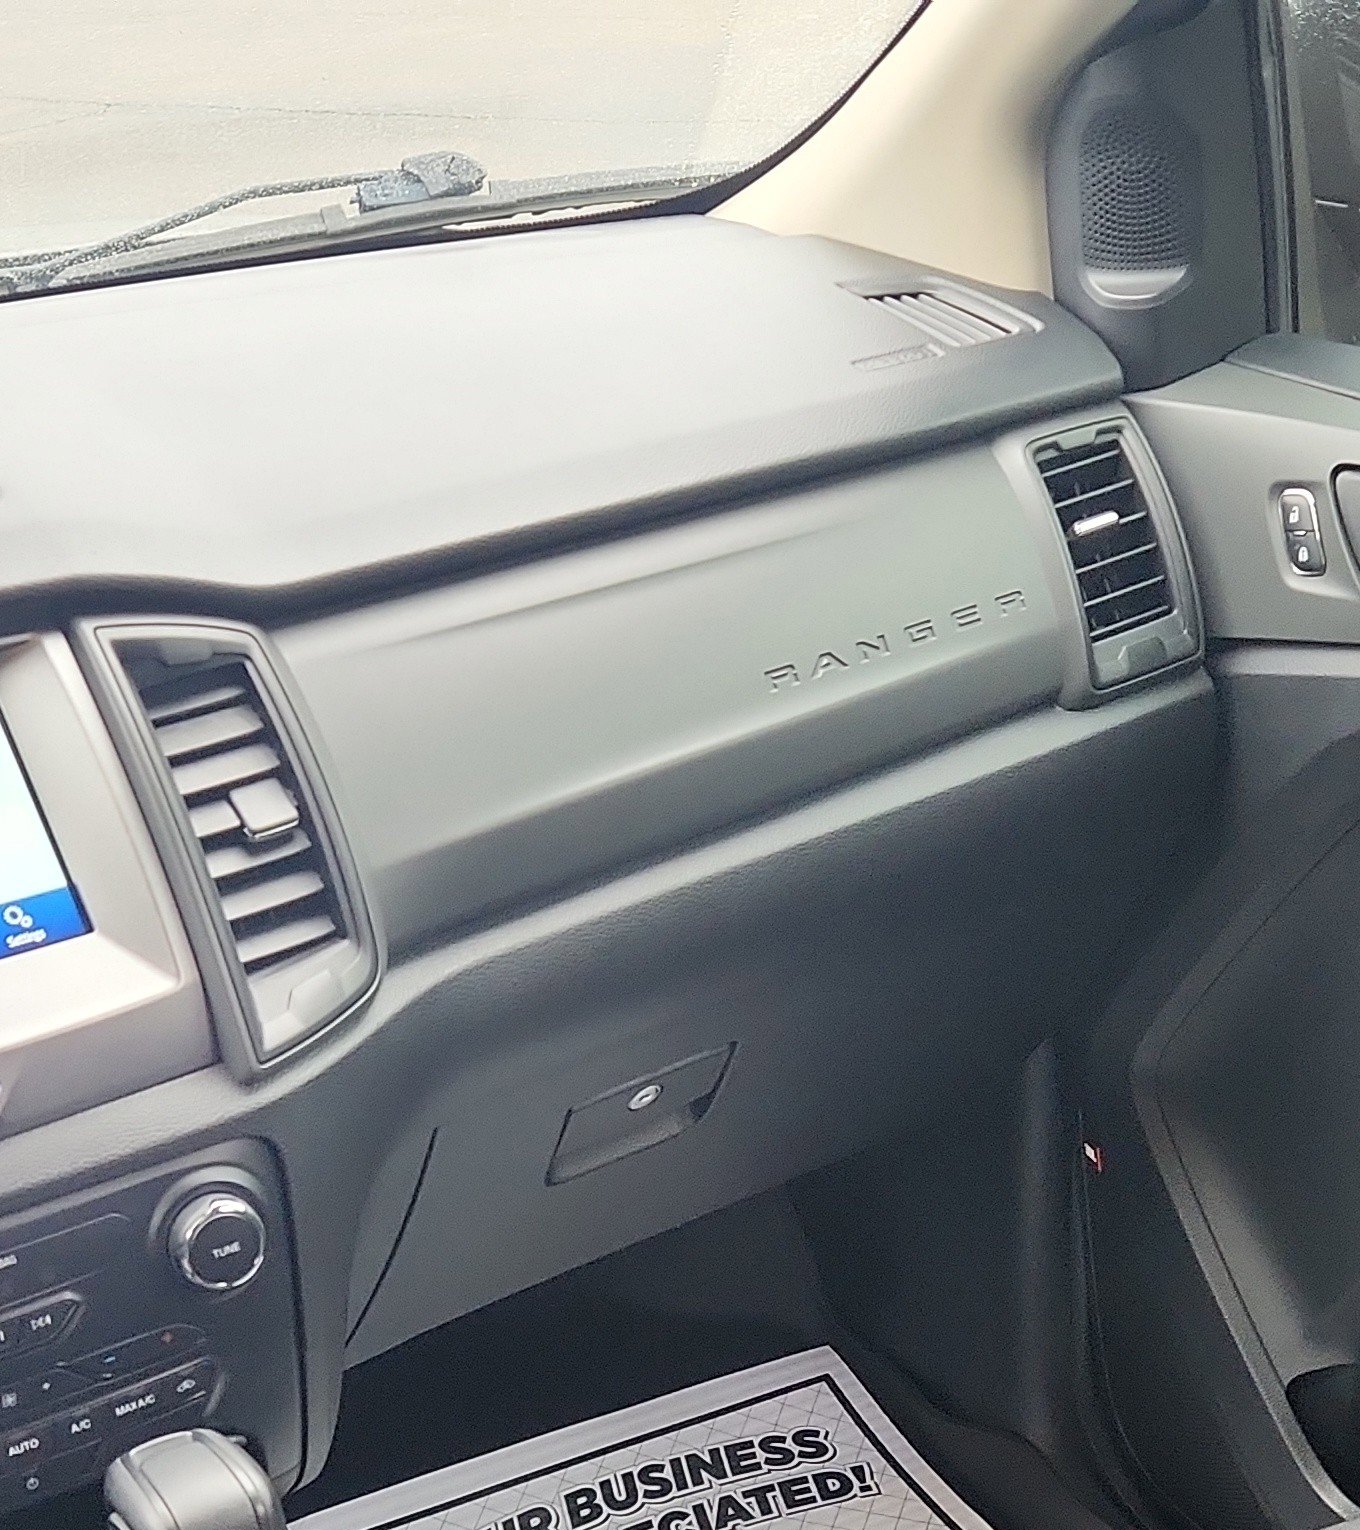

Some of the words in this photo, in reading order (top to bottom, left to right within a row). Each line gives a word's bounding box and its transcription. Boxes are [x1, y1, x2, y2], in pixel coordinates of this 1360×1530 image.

[763, 590, 1027, 693] RANGER
[212, 1241, 242, 1259] TUNE
[115, 1400, 138, 1417] MAX
[71, 1418, 91, 1434] A/C
[8, 1438, 40, 1457] AUTO
[563, 1428, 839, 1530] BUSINESS
